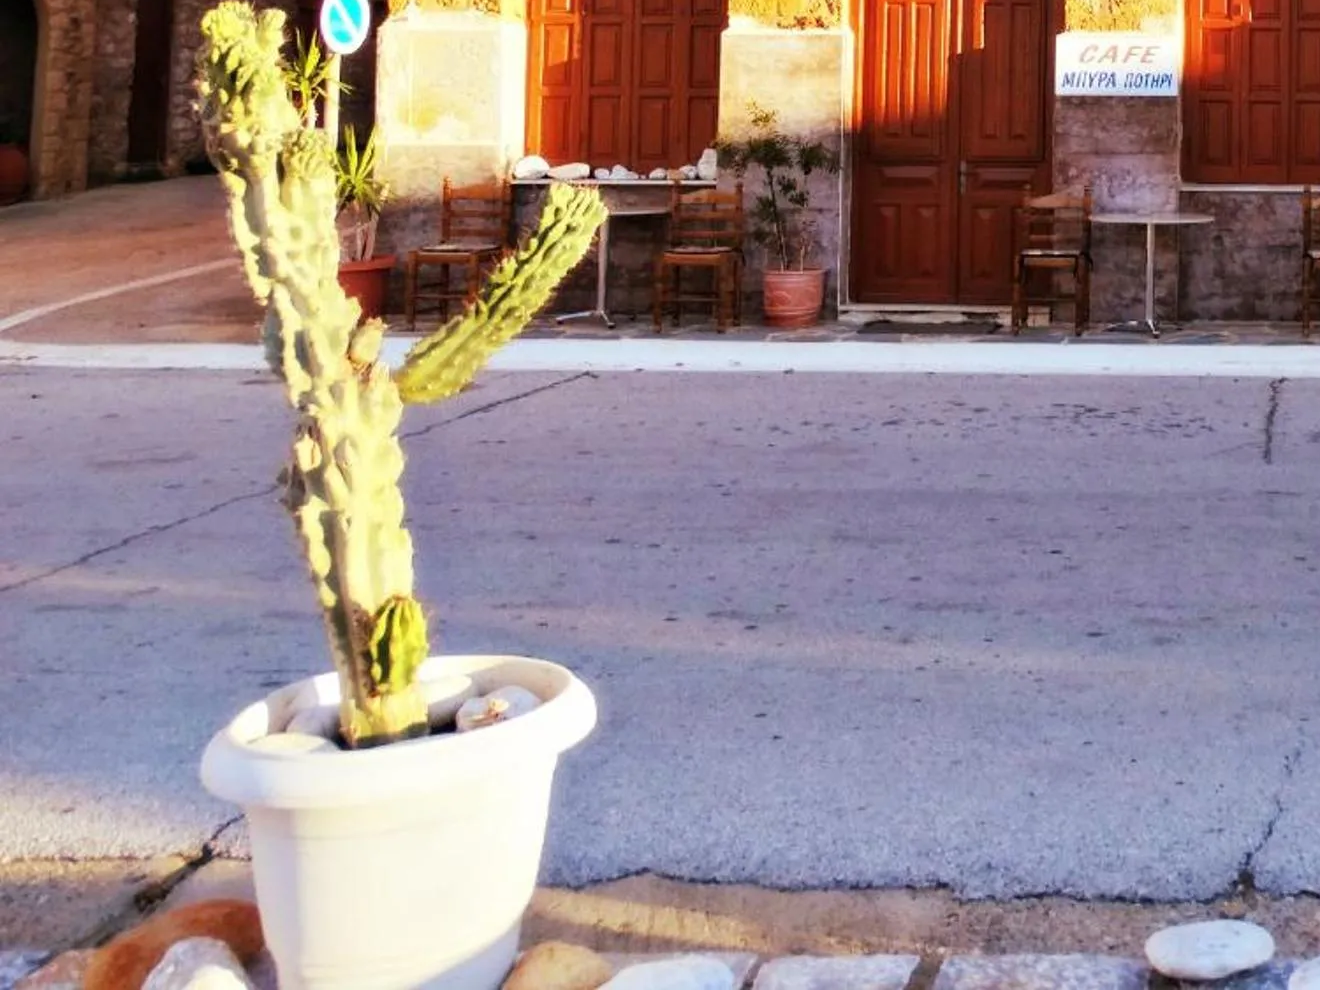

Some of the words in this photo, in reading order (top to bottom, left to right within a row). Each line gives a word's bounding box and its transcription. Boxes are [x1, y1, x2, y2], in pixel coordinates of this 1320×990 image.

[1079, 45, 1161, 64] CAFE
[1061, 71, 1117, 89] ΜΠΥΡΑ
[1123, 72, 1173, 89] ΠΟΤΗΡΙ
